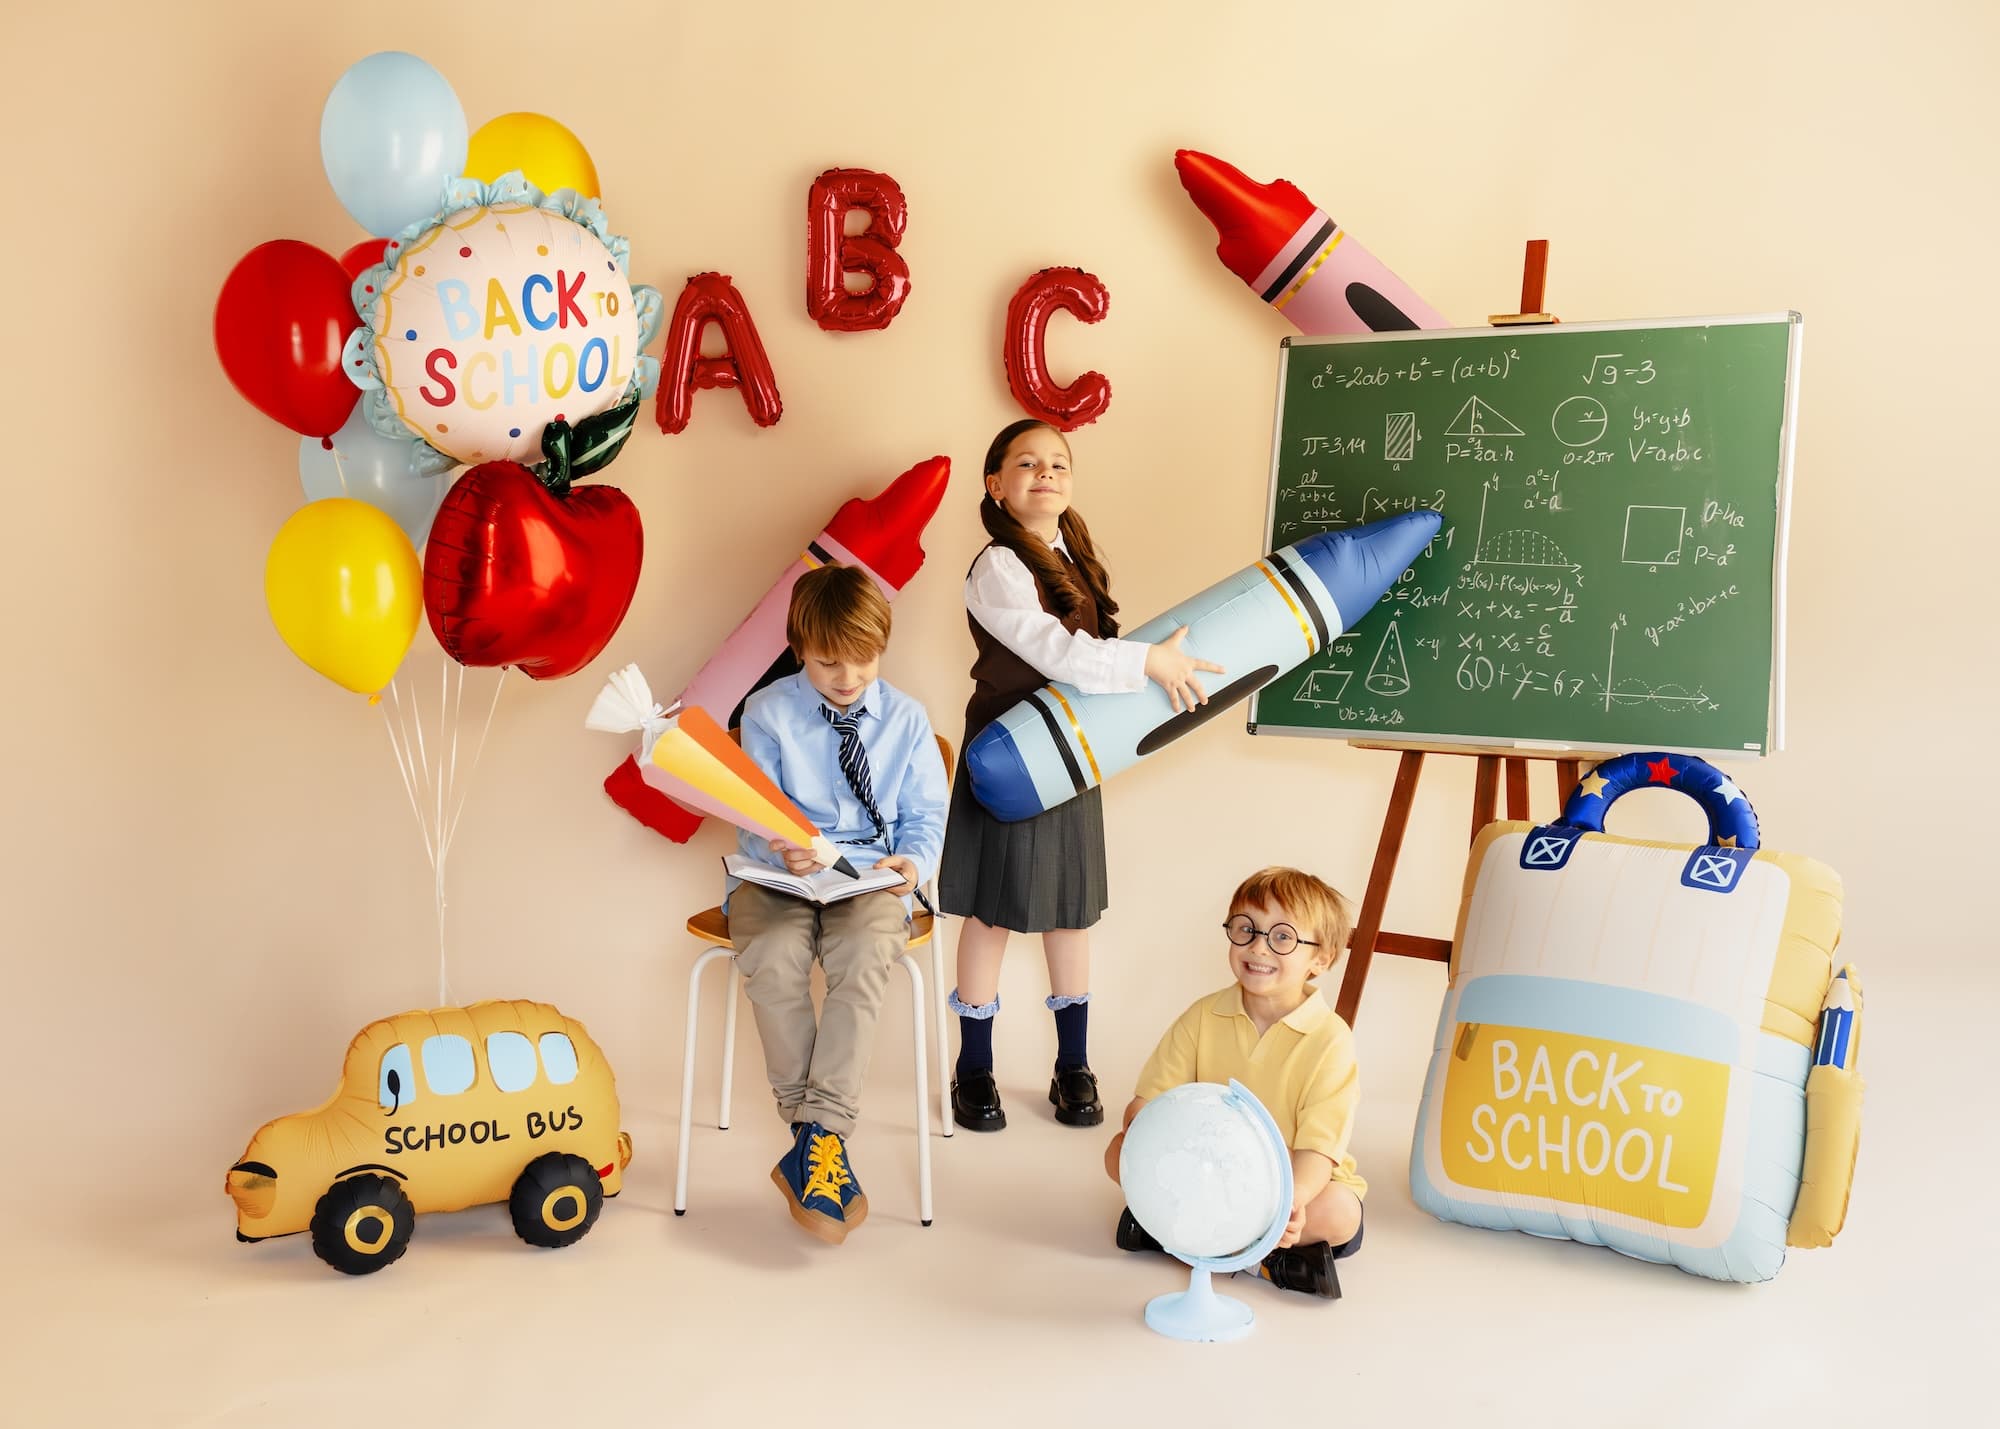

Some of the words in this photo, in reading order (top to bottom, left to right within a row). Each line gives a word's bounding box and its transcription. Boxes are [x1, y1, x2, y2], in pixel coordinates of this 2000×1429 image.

[436, 270, 588, 342] BACK
[591, 291, 619, 317] TO
[656, 272, 784, 434] A
[807, 168, 911, 332] B
[1004, 266, 1112, 432] C
[419, 336, 627, 408] SCHOOL
[1492, 1039, 1643, 1115] BACK
[1640, 1084, 1683, 1117] TO
[385, 1119, 510, 1154] SCHOOL
[526, 1105, 583, 1139] BUS
[1466, 1103, 1689, 1193] SCHOOL
